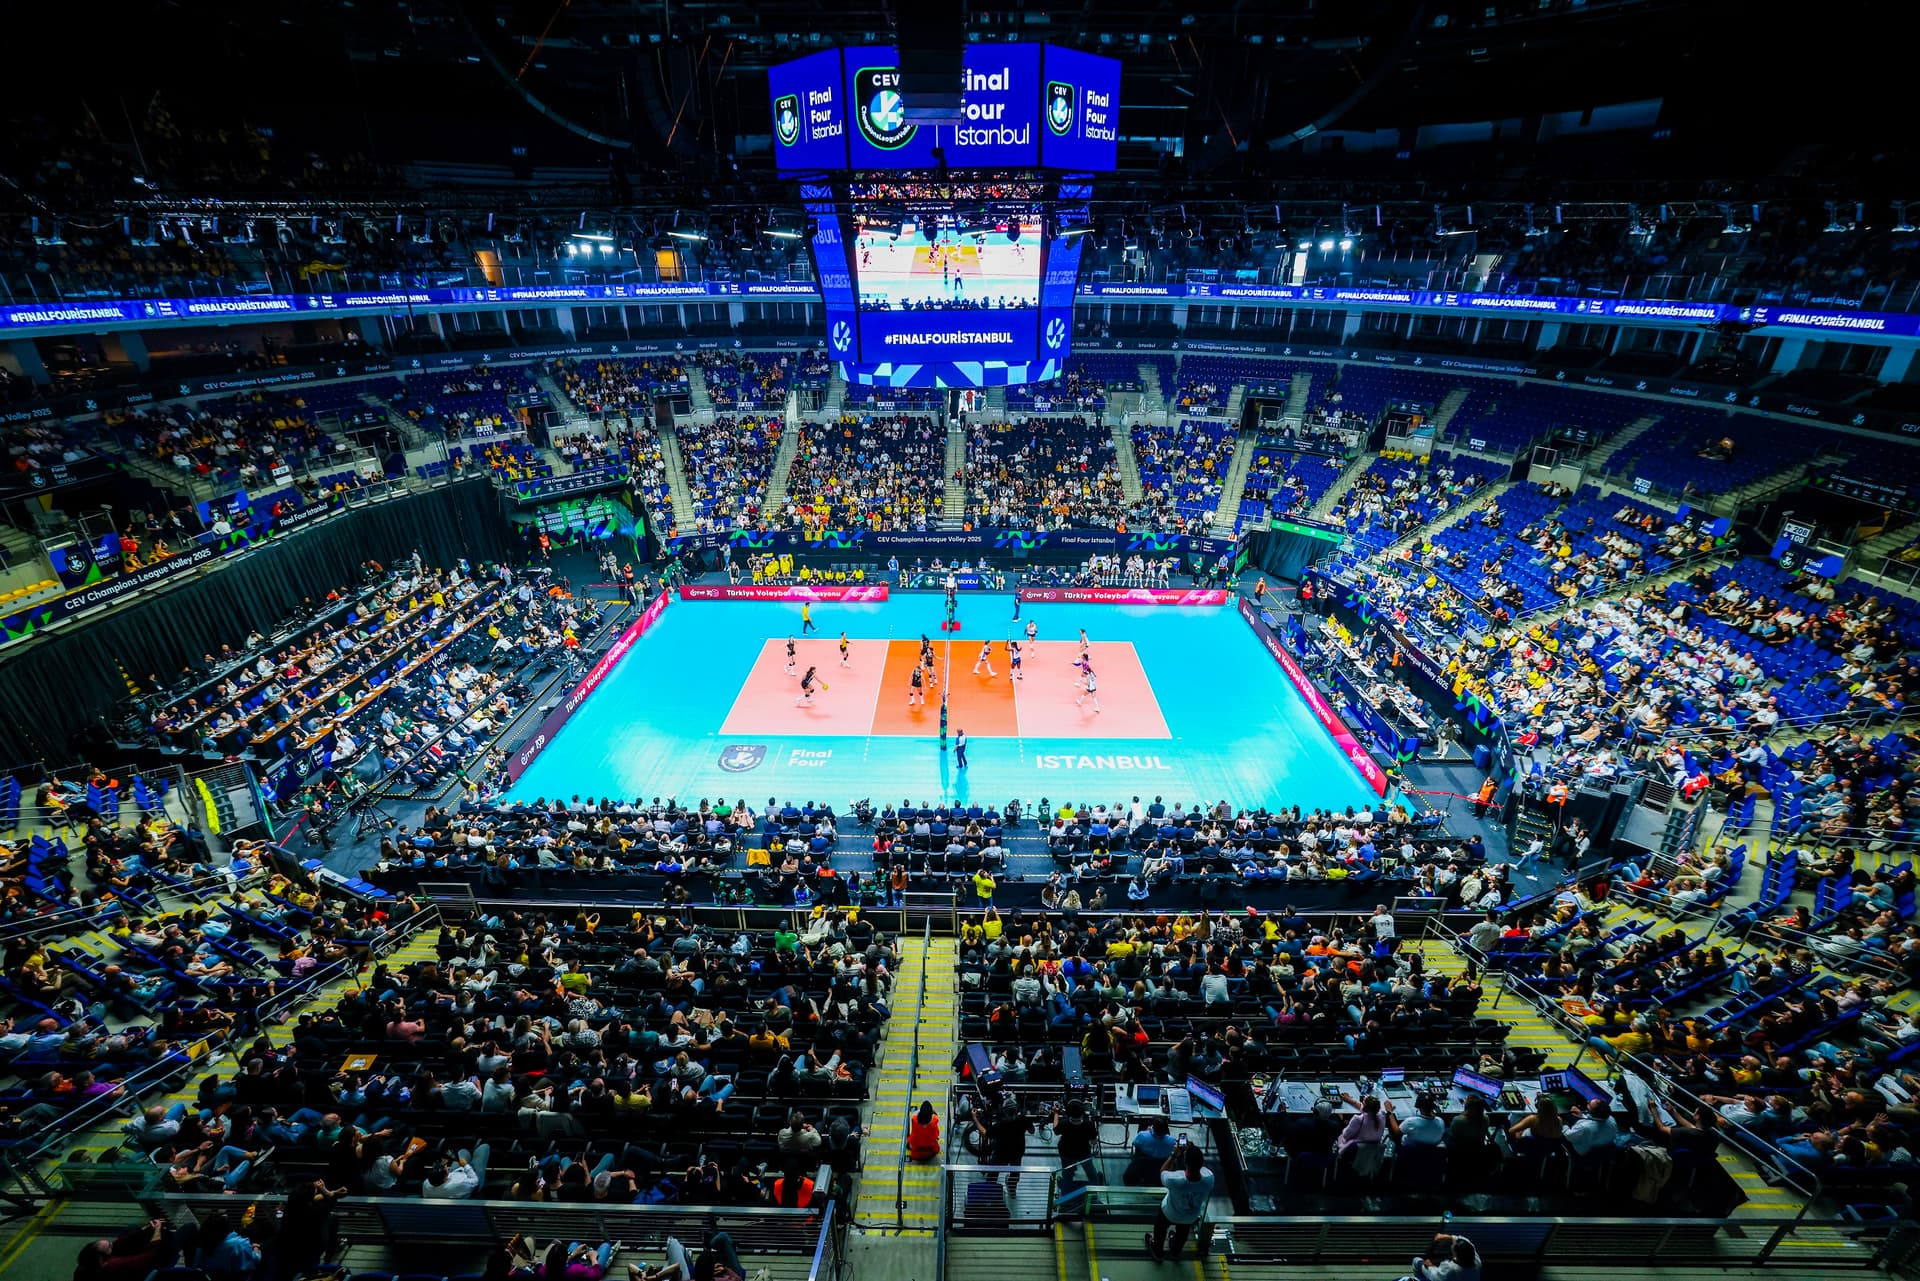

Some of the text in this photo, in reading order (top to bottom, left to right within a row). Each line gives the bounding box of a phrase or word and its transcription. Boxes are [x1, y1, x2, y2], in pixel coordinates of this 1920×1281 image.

[872, 73, 900, 87] CEV
[961, 67, 1009, 91] inal
[809, 86, 832, 106] Final
[1054, 86, 1067, 96] CEV
[1087, 90, 1109, 107] Final
[780, 99, 791, 109] CEV
[811, 109, 832, 124] Four
[1086, 108, 1107, 125] Four
[812, 120, 843, 140] Istanbul
[955, 122, 1029, 146] Istanbul
[1085, 124, 1116, 141] Istanbul
[884, 330, 1013, 346] #FINALFOURİSTANBUL
[64, 548, 212, 611] CEV Champions League Volley 2025
[791, 749, 833, 758] Final
[788, 758, 828, 767] Four
[1036, 754, 1171, 770] ISTANBUL
